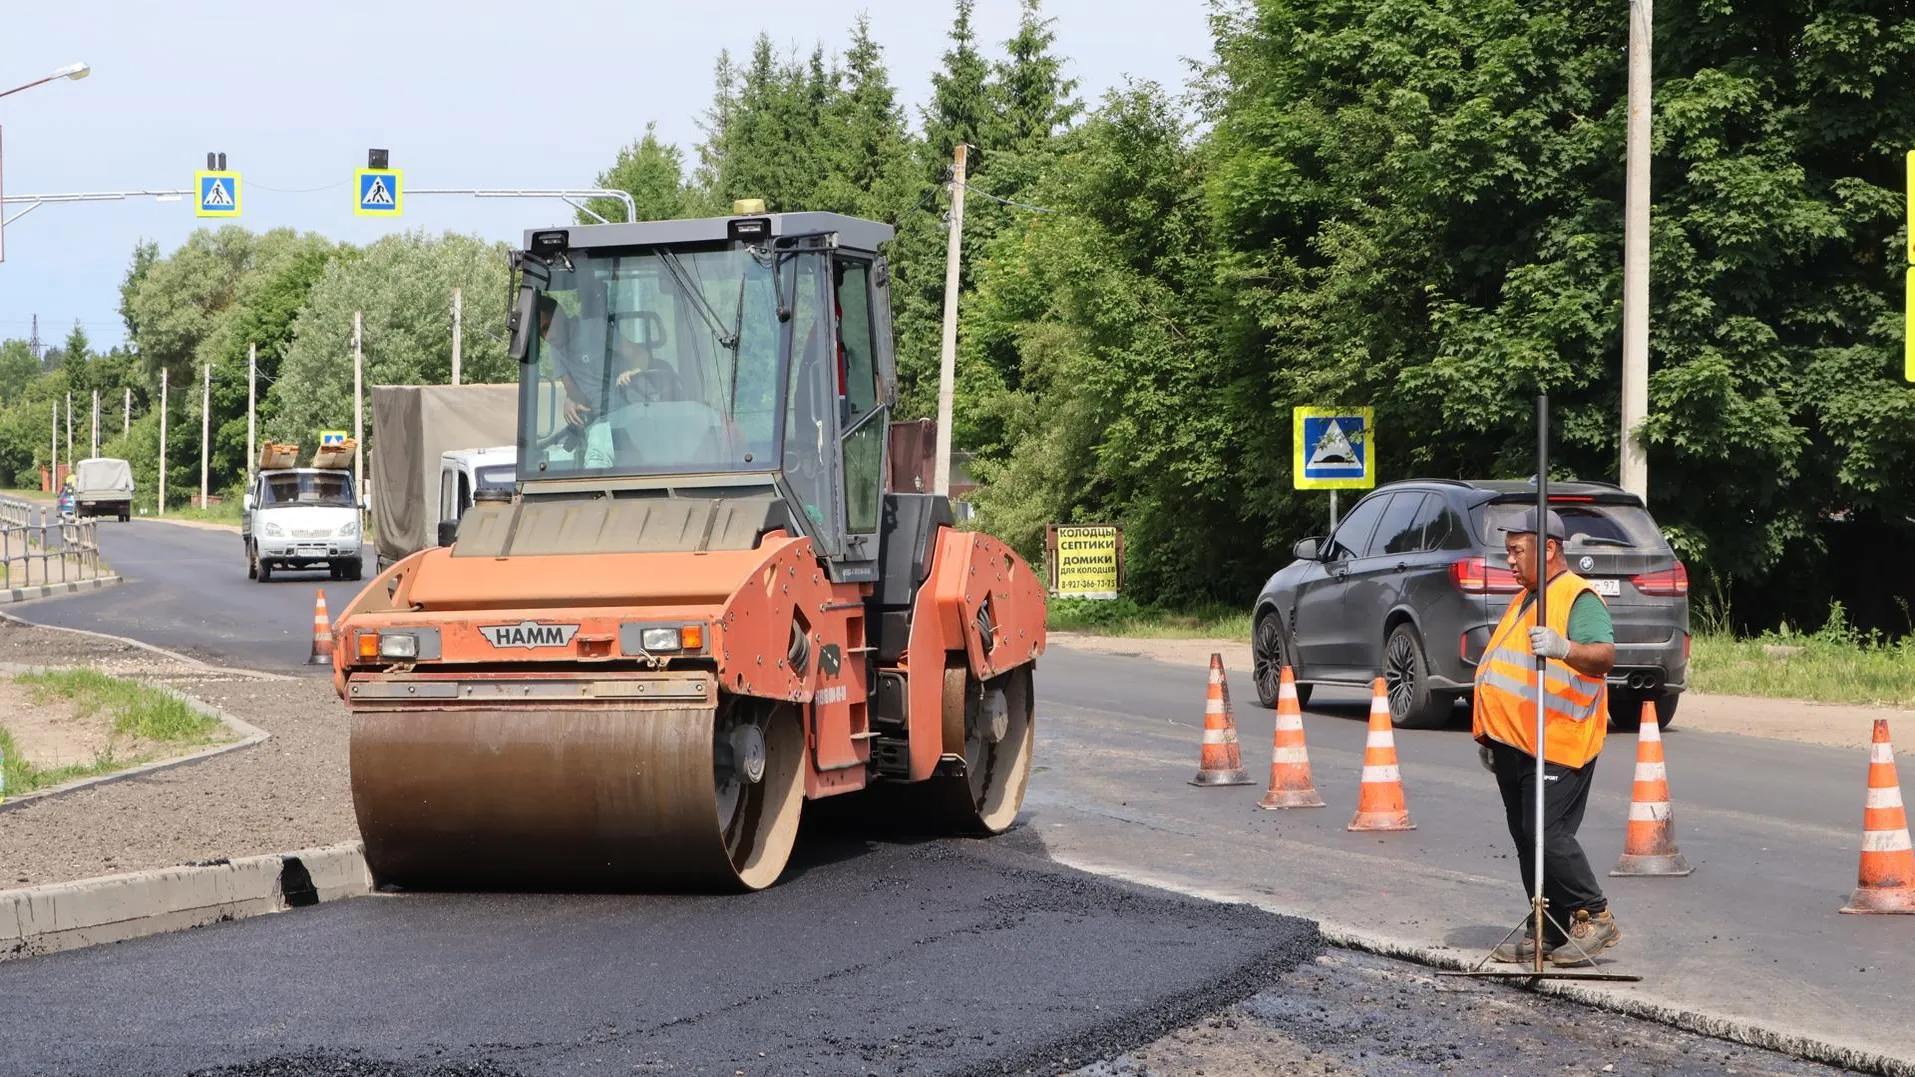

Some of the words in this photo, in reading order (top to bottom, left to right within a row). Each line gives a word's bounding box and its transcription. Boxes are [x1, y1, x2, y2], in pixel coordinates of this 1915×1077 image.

[1060, 528, 1114, 538] КОЛОДЦЫ
[1061, 541, 1114, 550] СЕПТИКИ
[1063, 556, 1112, 566] ДОМИКИ
[1060, 567, 1075, 575] ДЛЯ
[1603, 580, 1615, 590] 97
[496, 627, 564, 645] HAMM
